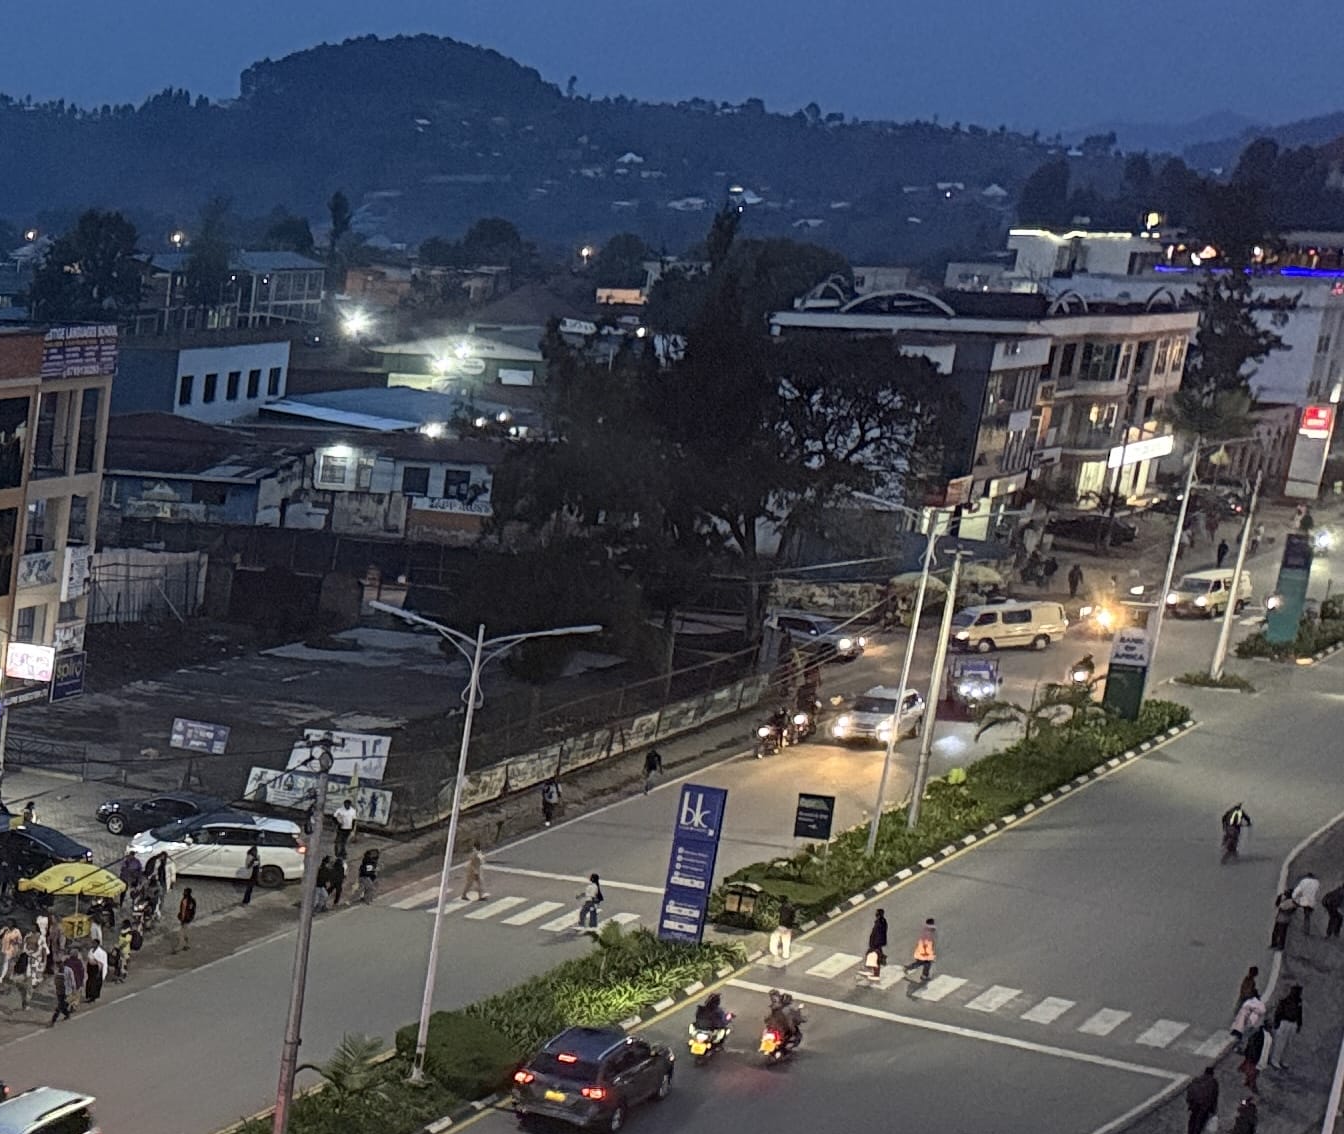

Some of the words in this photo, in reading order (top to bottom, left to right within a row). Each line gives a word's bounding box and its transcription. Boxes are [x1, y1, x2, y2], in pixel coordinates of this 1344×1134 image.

[1120, 636, 1145, 646] BANK
[1114, 652, 1145, 662] AFRICA
[680, 791, 711, 828] bk
